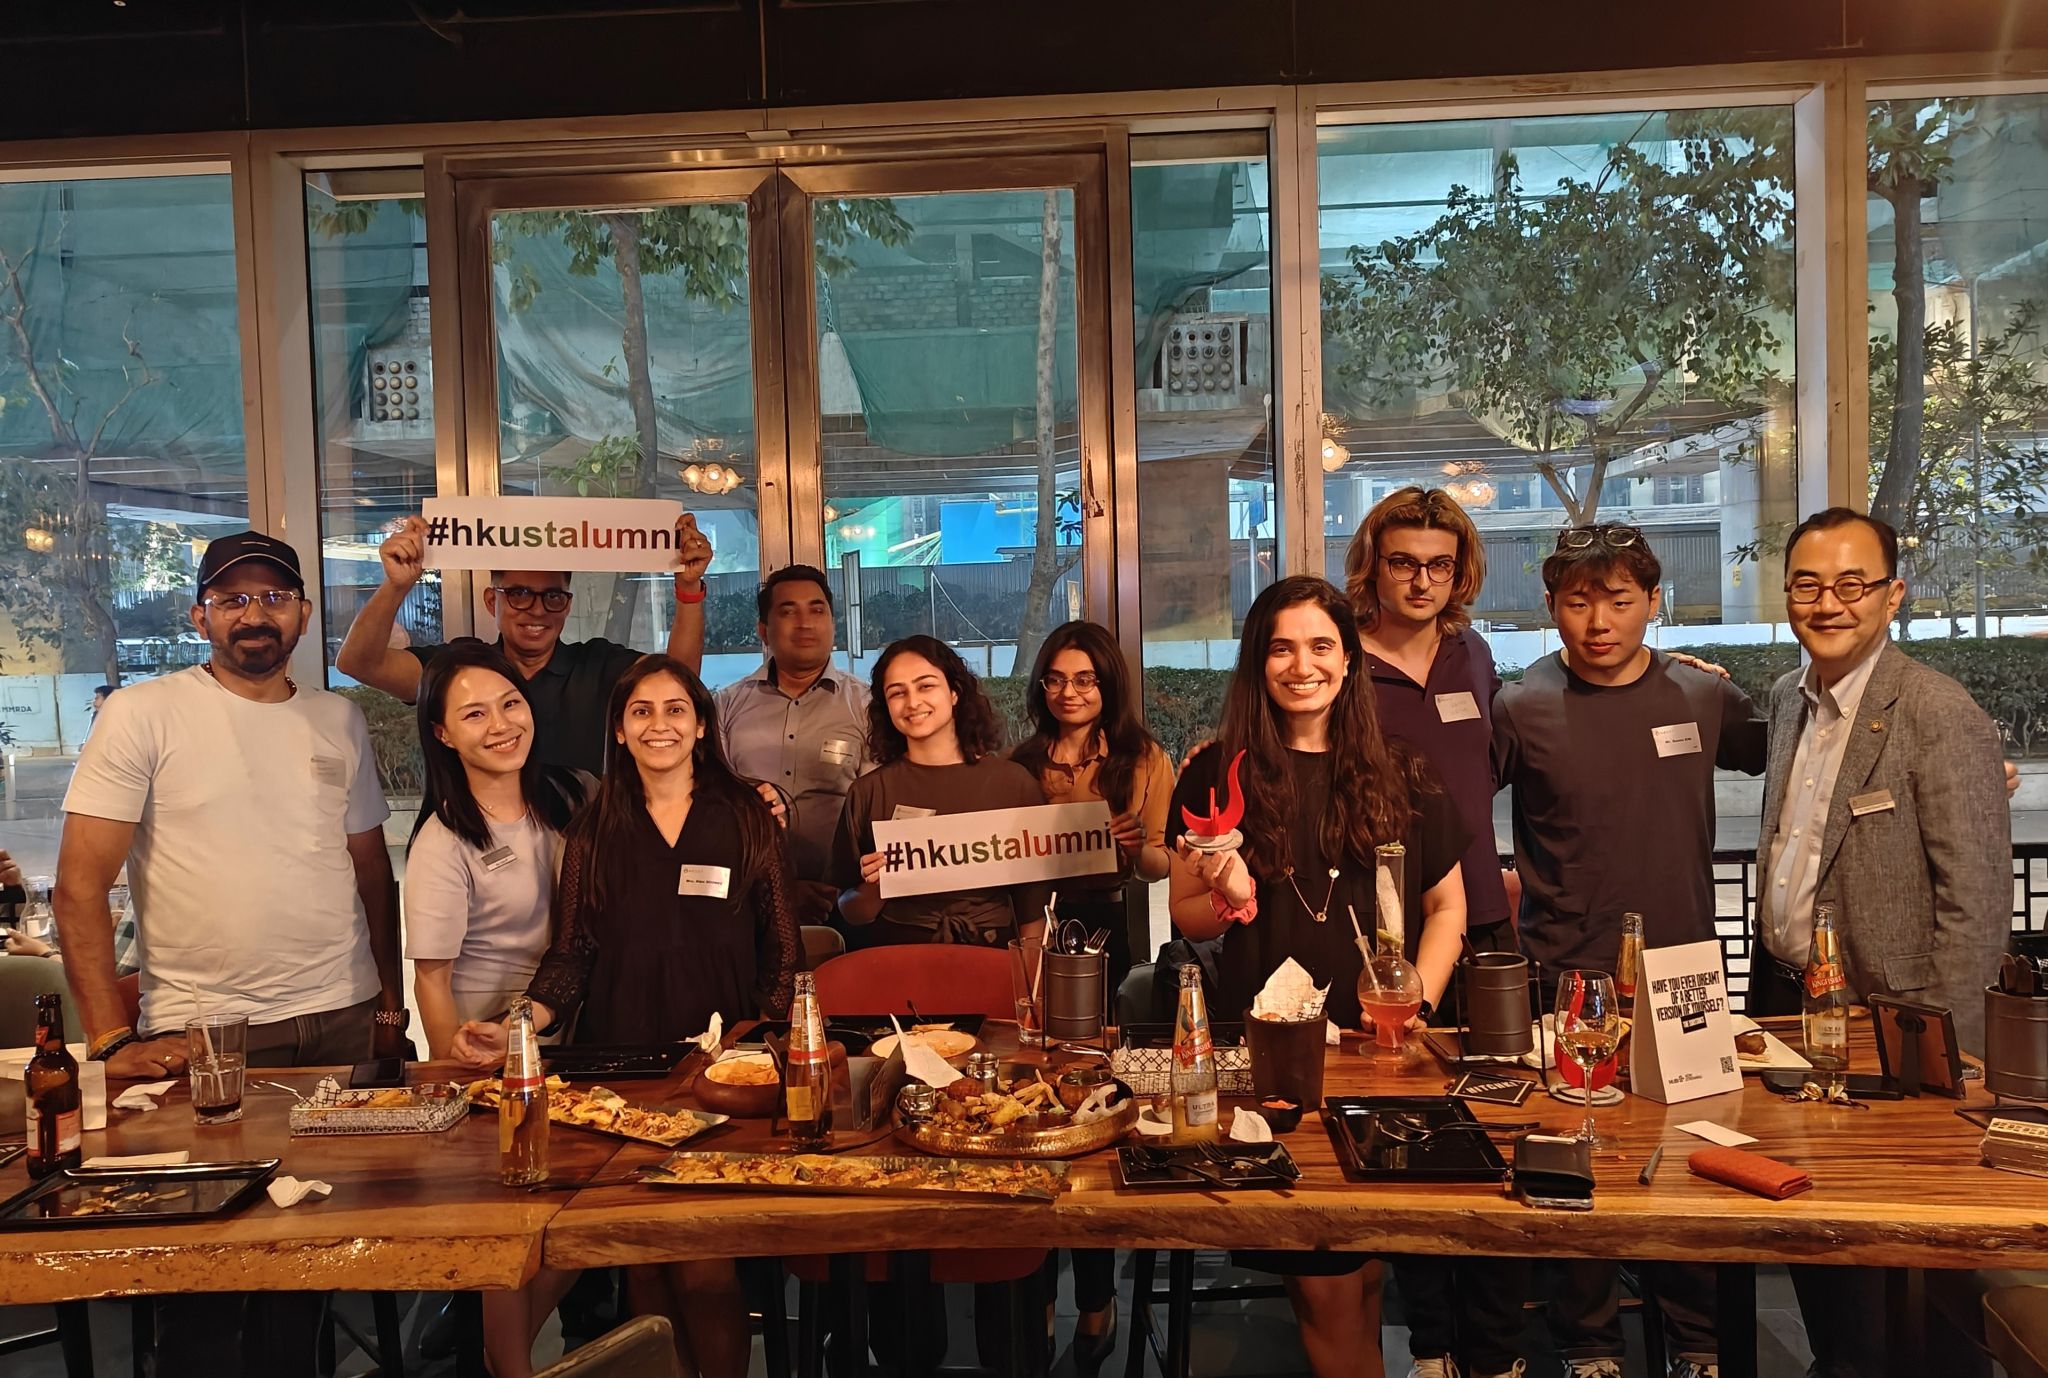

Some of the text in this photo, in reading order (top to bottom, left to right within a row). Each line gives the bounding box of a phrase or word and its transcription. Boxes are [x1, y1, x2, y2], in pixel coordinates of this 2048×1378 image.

[427, 517, 681, 550] #hkustalumni
[884, 821, 1112, 873] #hkustalumni
[1652, 971, 1720, 994] HAVE YOU EVER DREAMT
[1671, 987, 1708, 1004] OF A BETTER
[1657, 998, 1725, 1021] VERSION OF YOURSELF?
[1193, 1101, 1214, 1110] ULTRA
